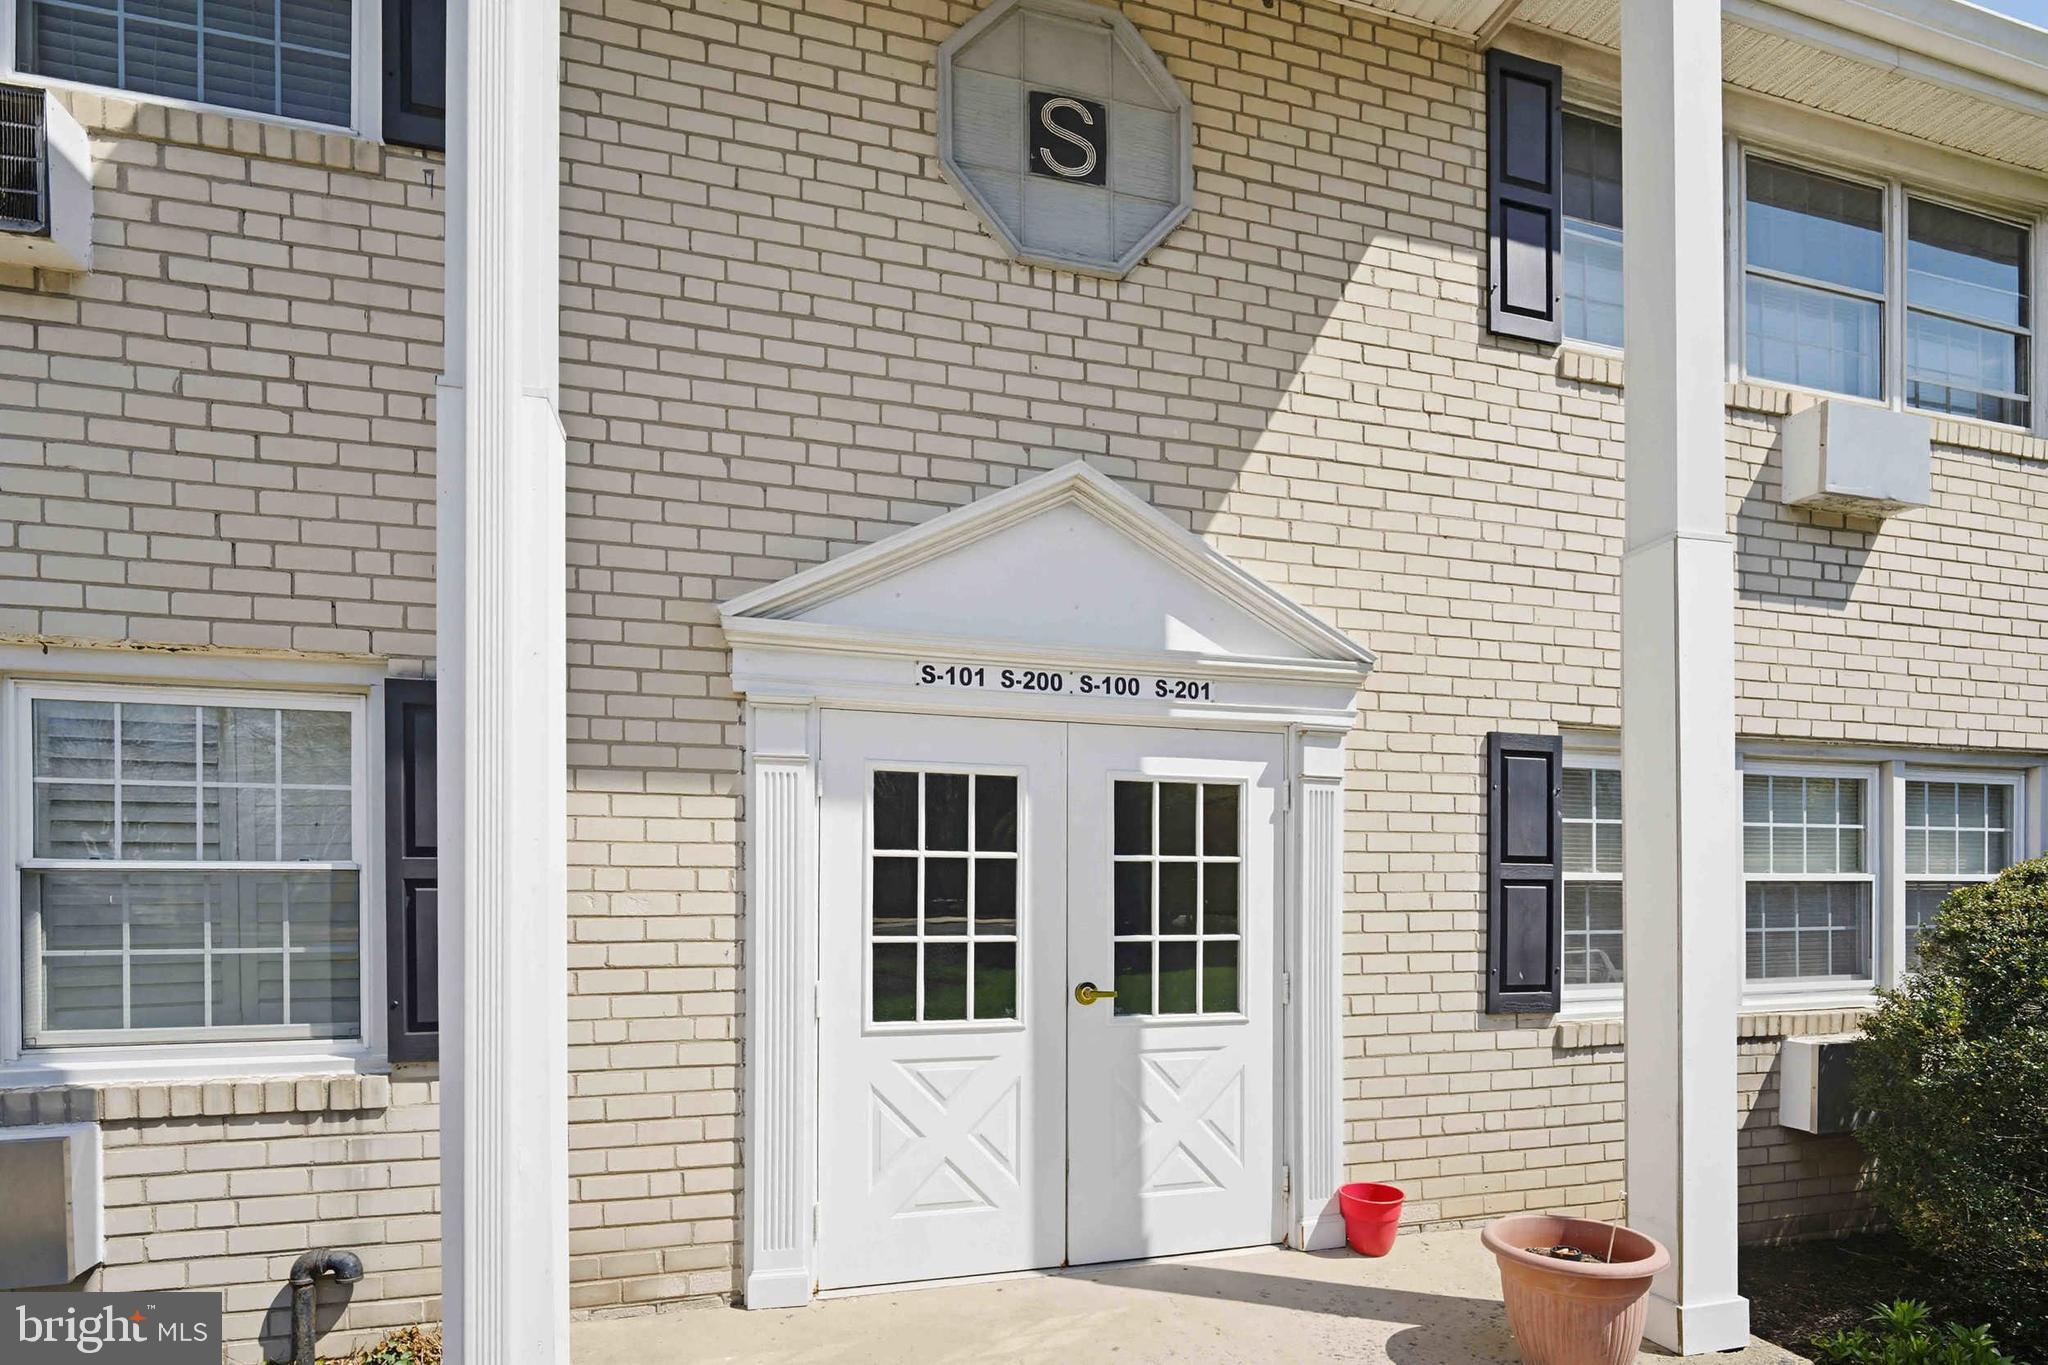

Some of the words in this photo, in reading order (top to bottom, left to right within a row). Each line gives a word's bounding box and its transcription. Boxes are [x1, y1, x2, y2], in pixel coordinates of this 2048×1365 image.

[1040, 97, 1097, 177] S
[921, 664, 985, 687] S-101
[1000, 669, 1063, 691] S-200
[1079, 674, 1140, 696] S-100
[1154, 679, 1210, 700] S-201
